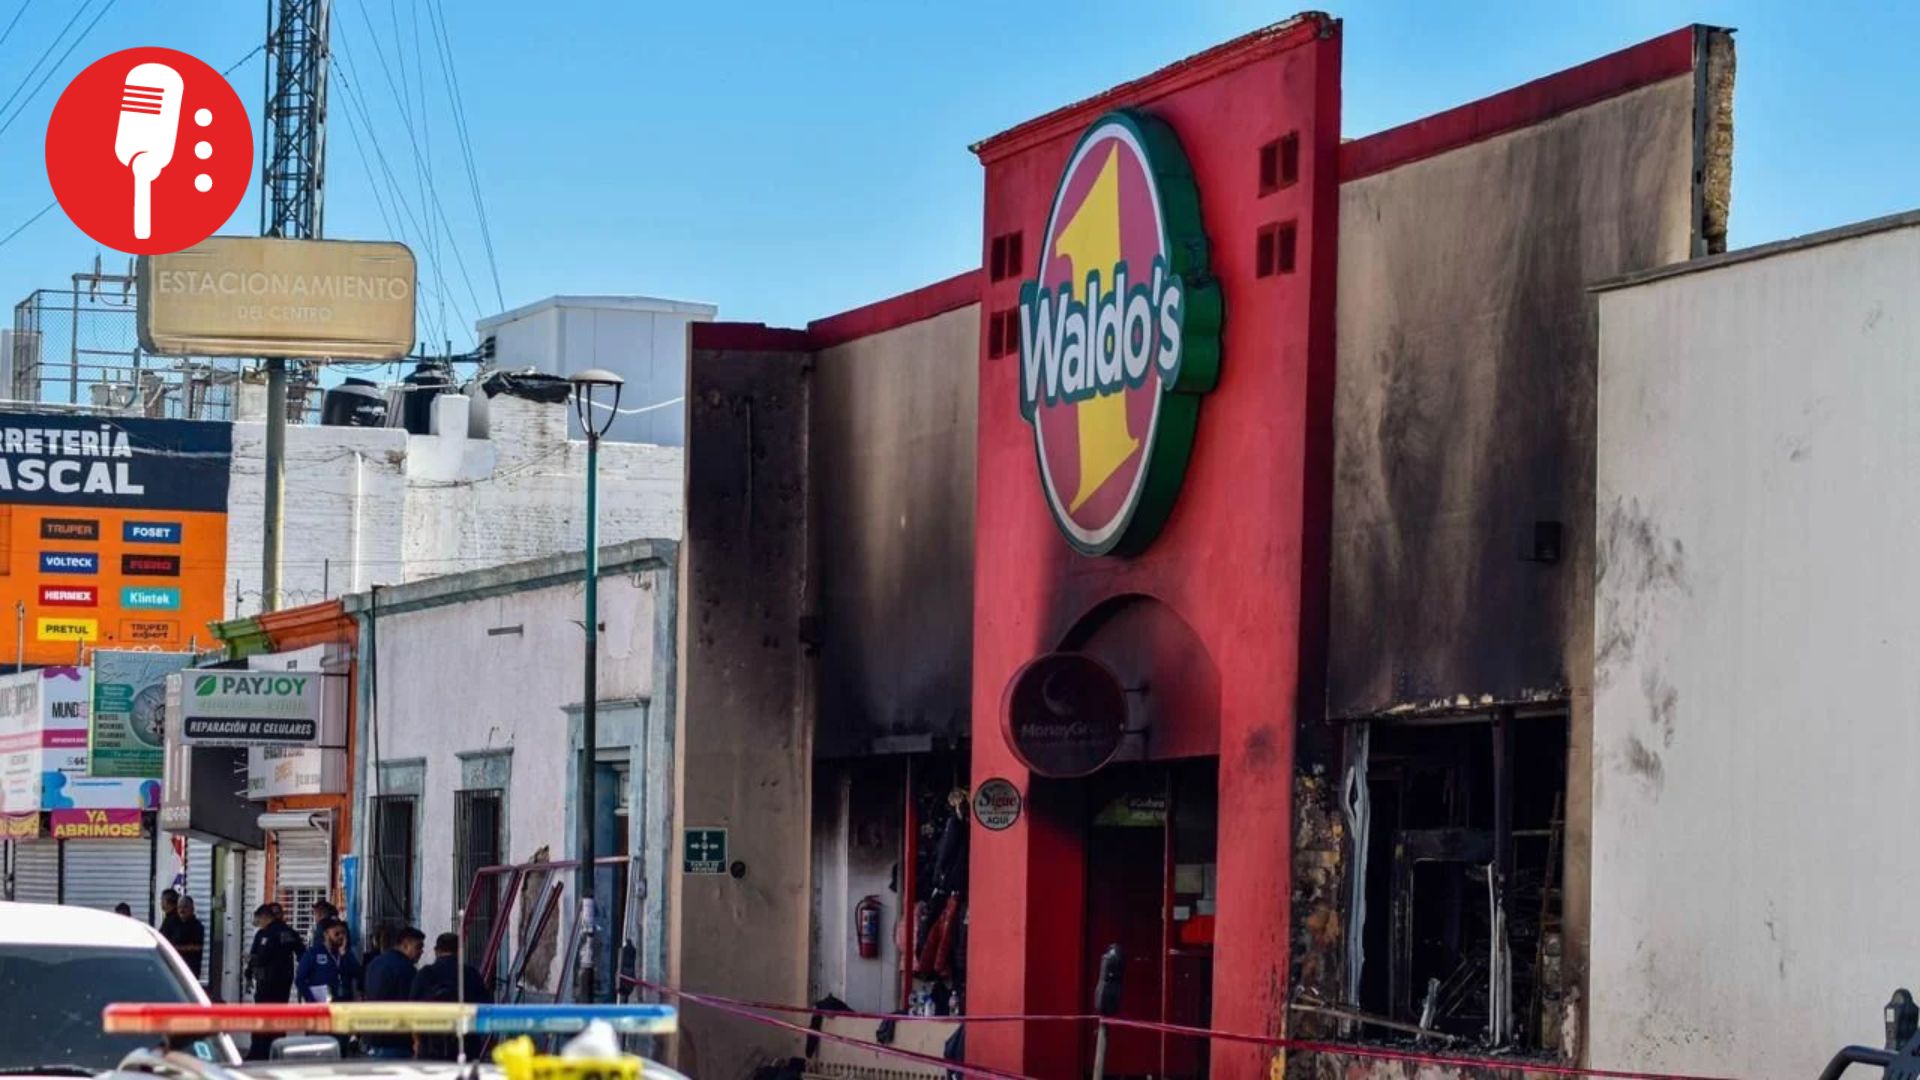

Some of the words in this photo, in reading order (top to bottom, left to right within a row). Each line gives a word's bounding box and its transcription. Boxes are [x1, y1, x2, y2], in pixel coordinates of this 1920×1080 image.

[158, 271, 408, 300] ESTACIONAMIENTO
[238, 305, 265, 320] DEL
[269, 305, 333, 321] CENTRO
[1020, 266, 1181, 403] Waldo's
[0, 424, 133, 458] RETERÍA
[47, 524, 93, 535] TRUPER
[133, 527, 171, 538] FOSET
[44, 590, 92, 601] HERMEX
[130, 592, 170, 604] Klintek
[46, 624, 89, 634] PRETUL
[223, 677, 307, 695] PAYJOY
[190, 720, 248, 734] REPARACIÓN
[250, 721, 260, 733] DE
[263, 722, 312, 735] CELULARES
[86, 810, 109, 823] YA
